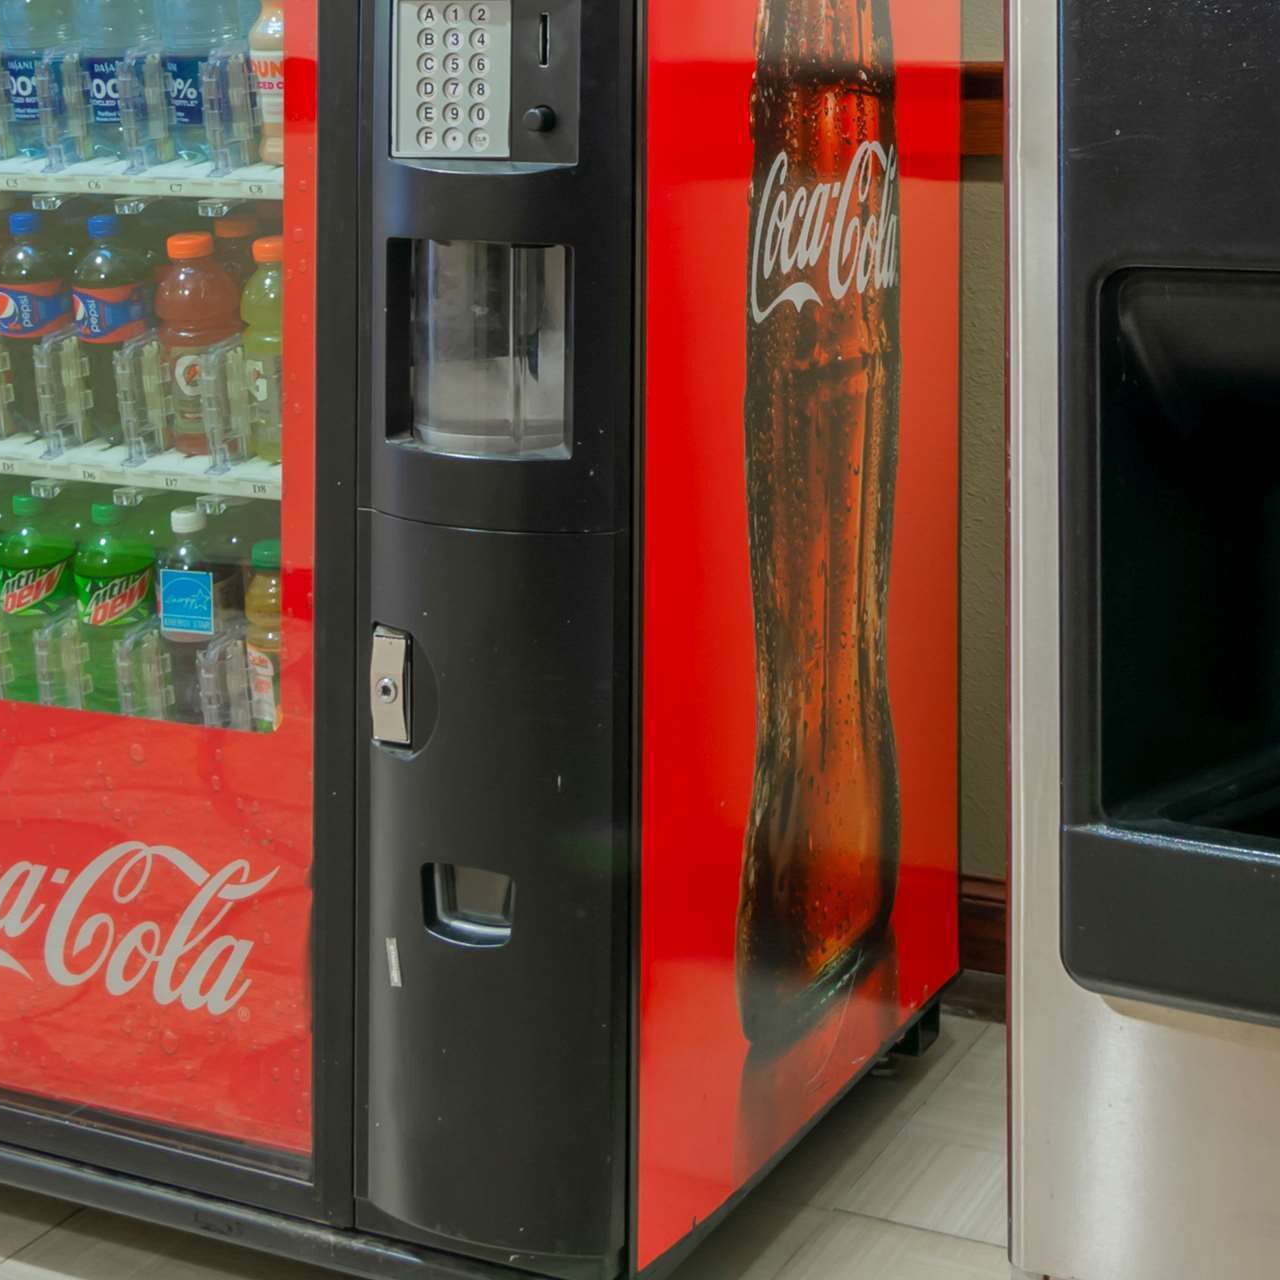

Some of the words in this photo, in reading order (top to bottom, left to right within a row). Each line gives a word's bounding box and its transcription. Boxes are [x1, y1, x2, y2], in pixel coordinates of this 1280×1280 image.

[424, 8, 434, 21] A
[453, 8, 458, 21] 1
[478, 8, 486, 21] 2
[424, 33, 434, 46] B
[451, 33, 459, 46] 3
[477, 33, 485, 46] 4
[94, 61, 117, 73] DASA
[424, 57, 434, 71] C
[451, 58, 459, 71] 5
[477, 58, 485, 71] 6
[424, 82, 434, 95] D
[451, 83, 459, 95] 7
[477, 82, 485, 96] 8
[424, 107, 433, 120] E
[451, 107, 459, 120] 9
[477, 108, 485, 121] 0
[424, 131, 433, 144] F
[6, 179, 18, 188] C5
[88, 181, 101, 190] C6
[170, 183, 183, 193] C7
[249, 184, 263, 195] C8
[751, 140, 898, 324] Coca-Cola
[18, 295, 33, 328] pepsi
[88, 299, 102, 333] pepsi
[2, 463, 15, 472] D5
[82, 470, 96, 481] D6
[165, 478, 178, 488] D7
[253, 485, 266, 495] D8
